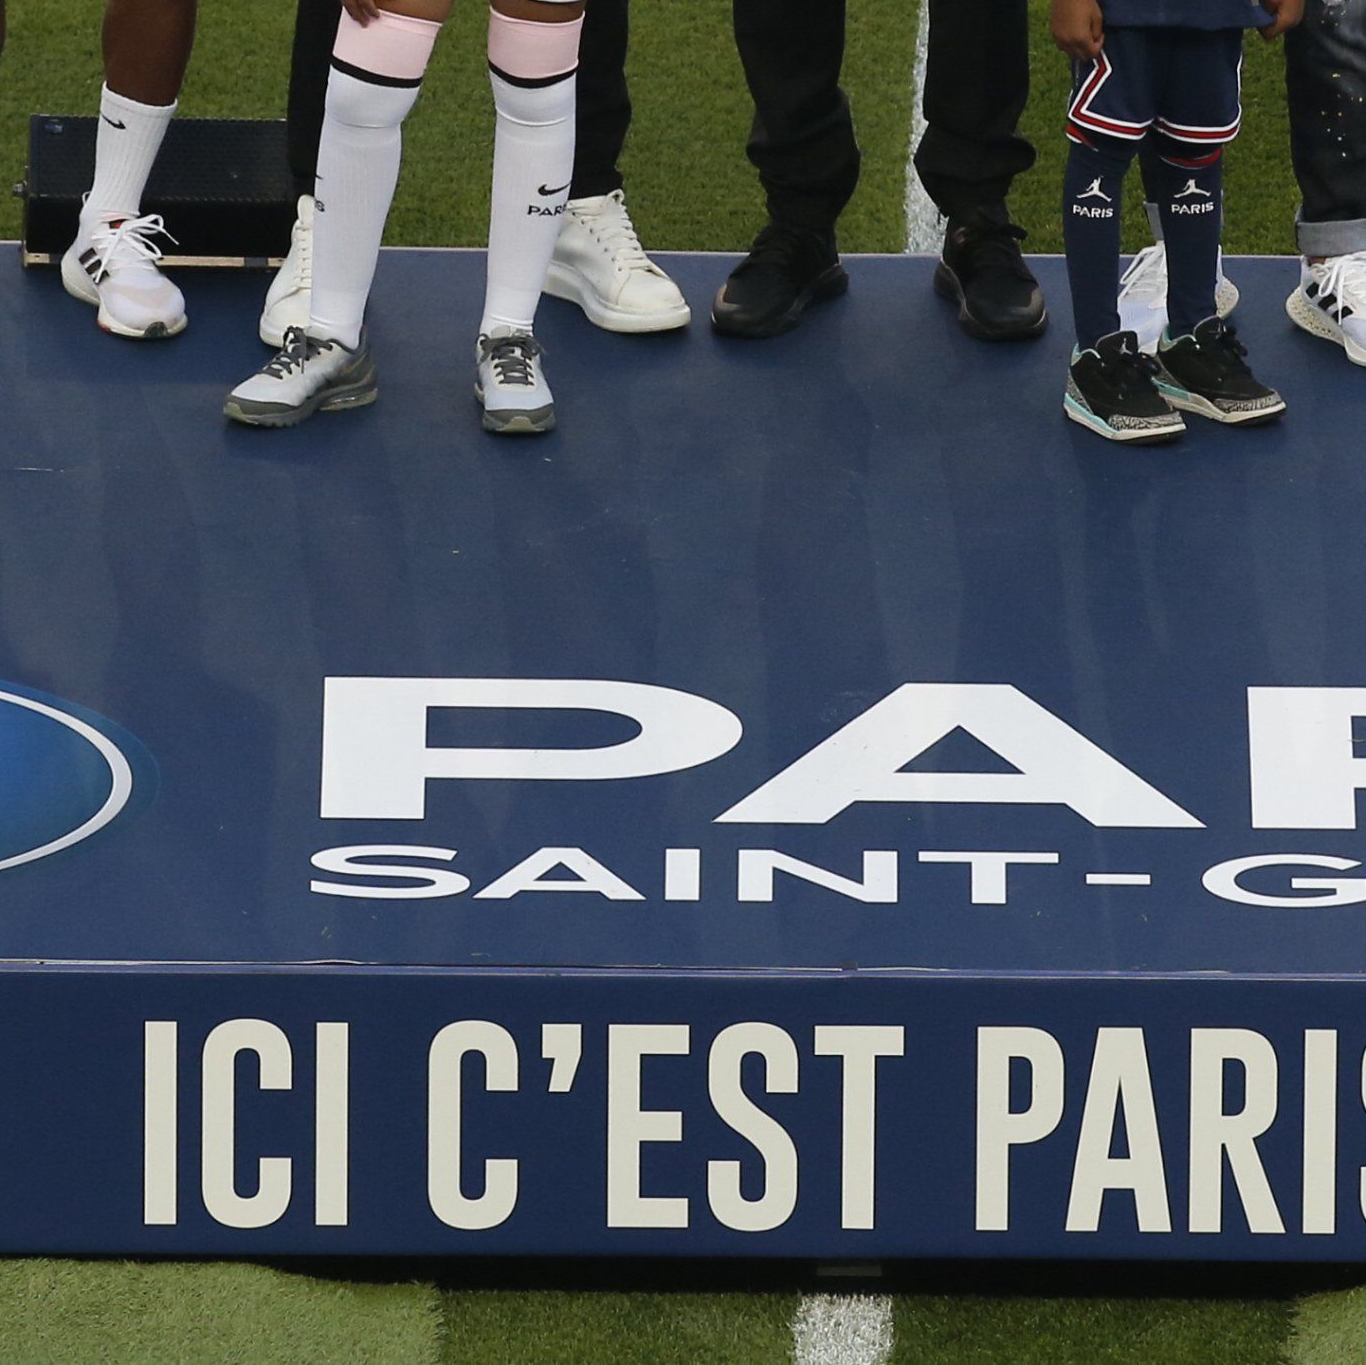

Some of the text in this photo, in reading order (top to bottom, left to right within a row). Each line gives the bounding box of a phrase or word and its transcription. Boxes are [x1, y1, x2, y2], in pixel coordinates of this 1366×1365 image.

[1073, 204, 1114, 218] PARIS
[1171, 202, 1214, 214] PARIS
[144, 1019, 348, 1228] ICI
[427, 1019, 905, 1231] C'EST
